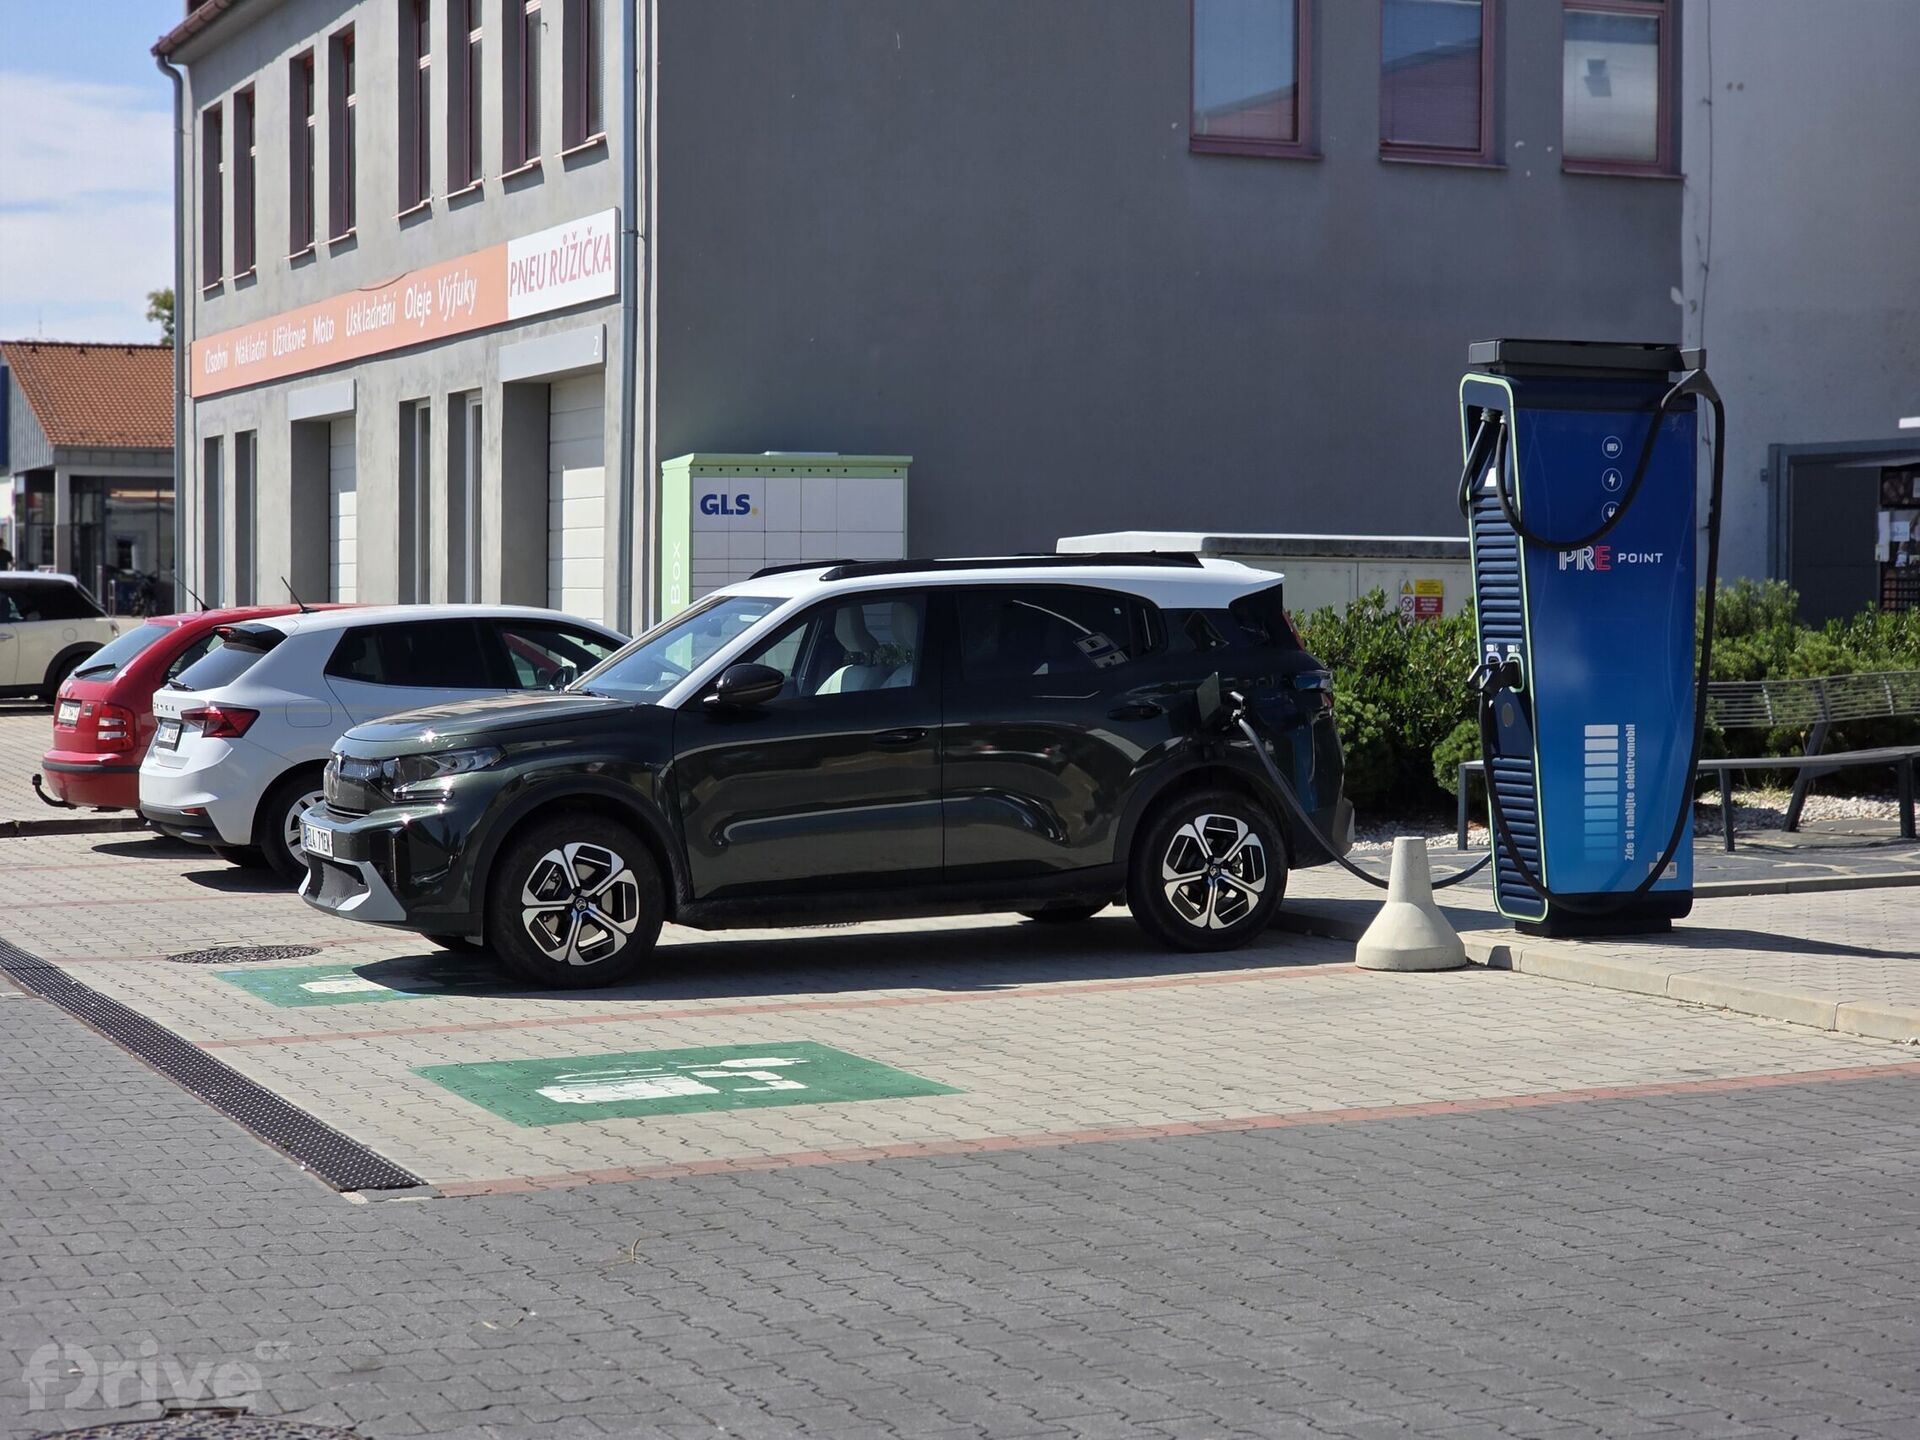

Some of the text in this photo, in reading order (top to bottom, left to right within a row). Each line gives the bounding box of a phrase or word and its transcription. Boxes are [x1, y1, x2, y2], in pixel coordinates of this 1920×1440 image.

[509, 226, 612, 298] PNEU RŮŽIČKA
[271, 319, 307, 357] Užitkové
[312, 315, 335, 345] Moto
[345, 290, 397, 337] Uskladnění
[404, 281, 433, 329] Oleje
[438, 268, 478, 322] Výfuky
[593, 335, 599, 356] 2
[1559, 545, 1664, 571] PRE POINT
[1625, 724, 1636, 790] elektromobil
[1625, 842, 1635, 861] Zde
